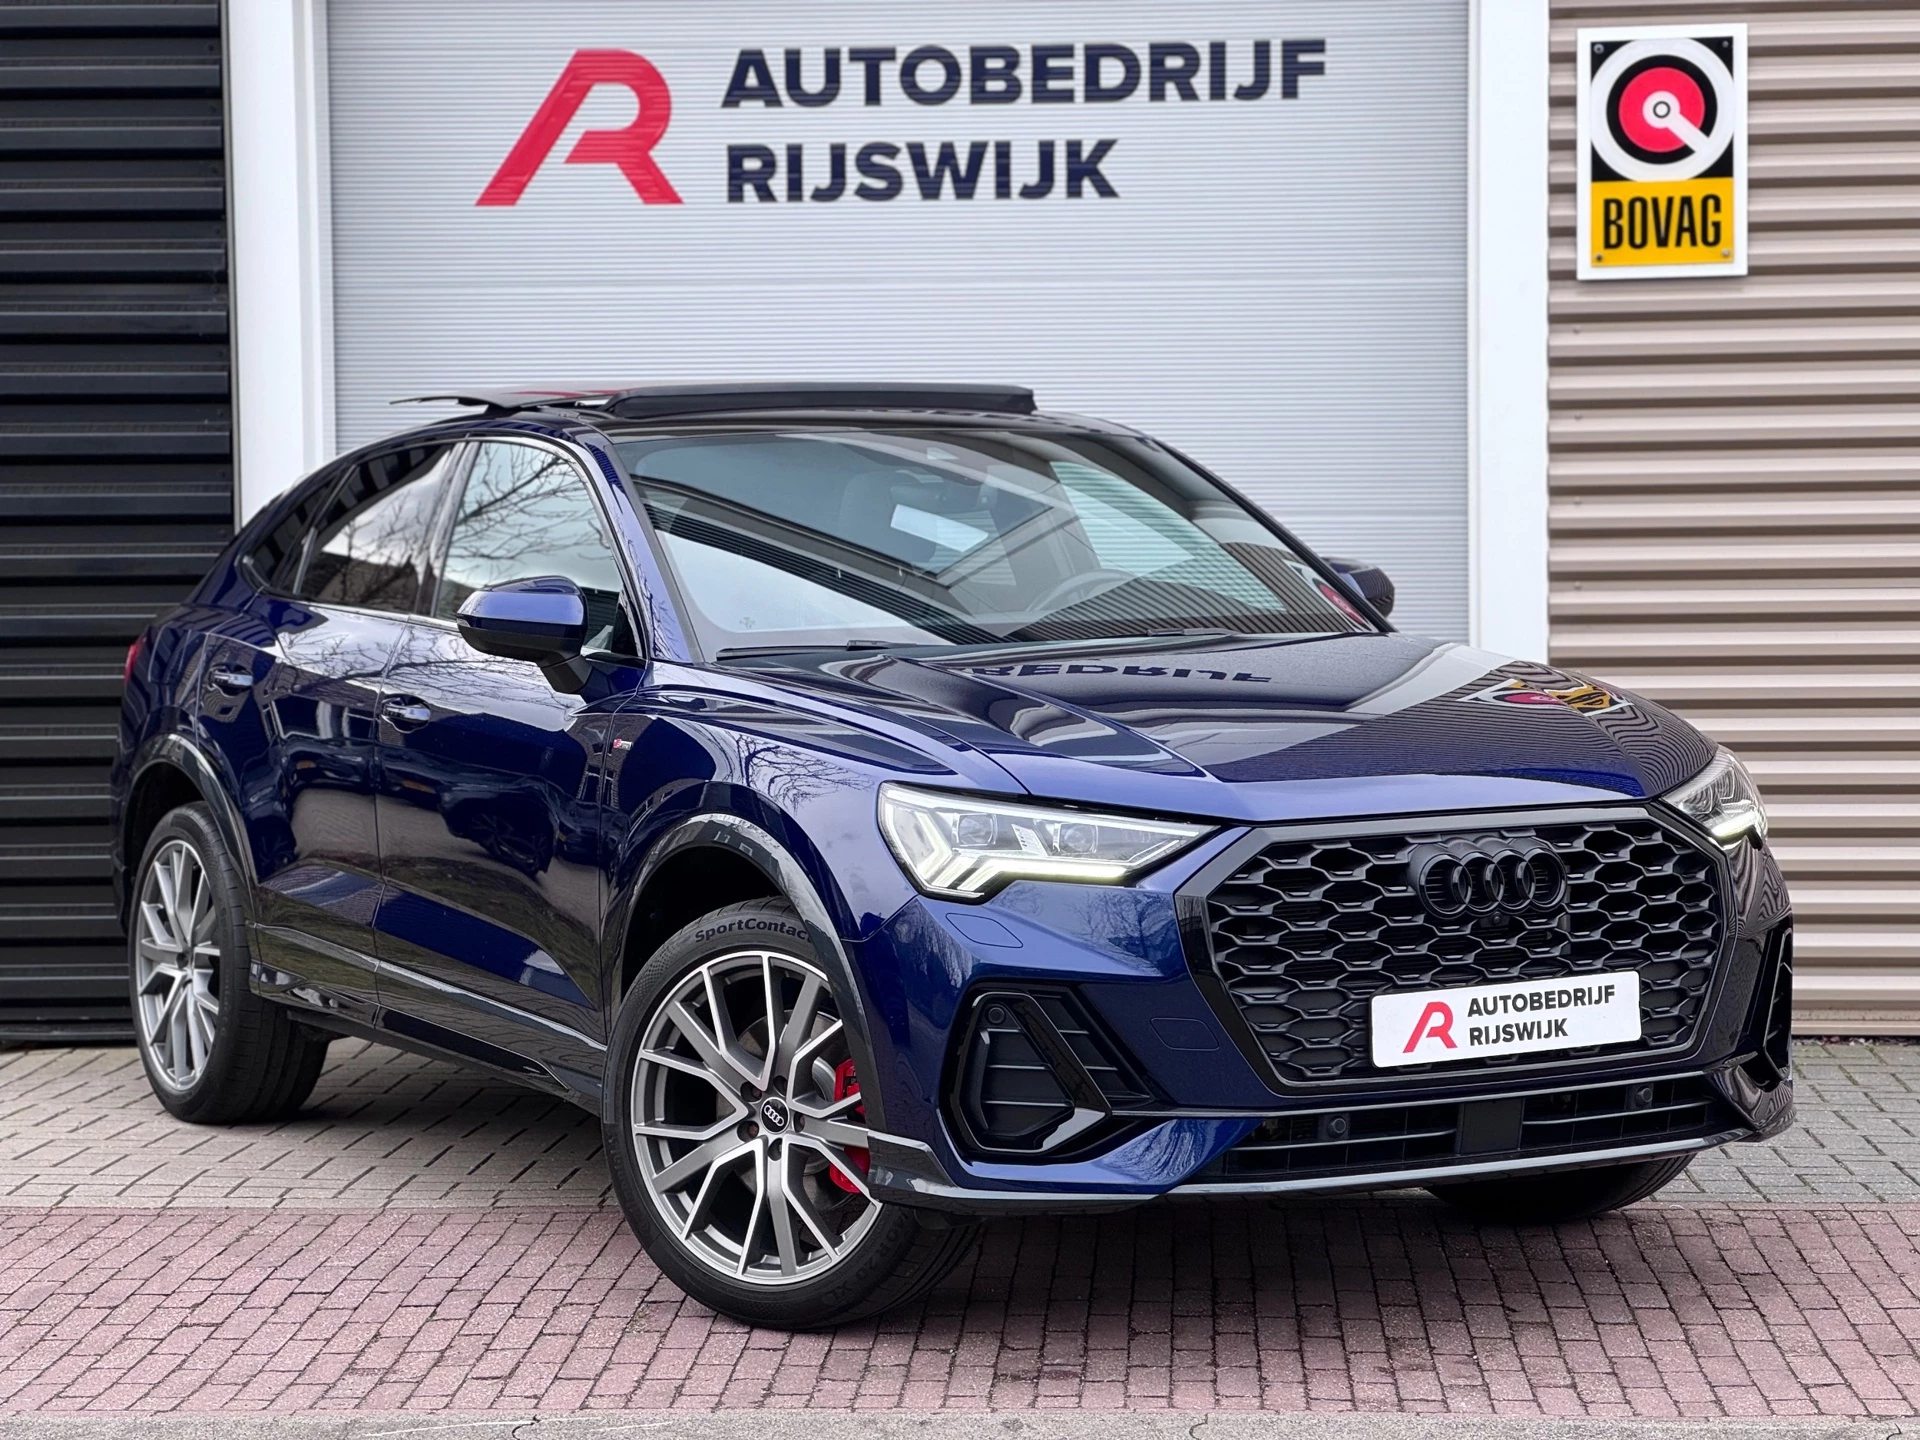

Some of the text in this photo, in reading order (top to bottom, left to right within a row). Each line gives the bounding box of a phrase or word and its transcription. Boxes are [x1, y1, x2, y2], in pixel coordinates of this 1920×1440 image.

[722, 39, 1326, 108] AUTOBEDRIJF
[727, 139, 1120, 203] RIJSWIJK
[1603, 194, 1721, 250] BOVAG
[1467, 985, 1615, 1017] AUTOBEDRIJF
[1469, 1018, 1568, 1046] RIJSWIJK
